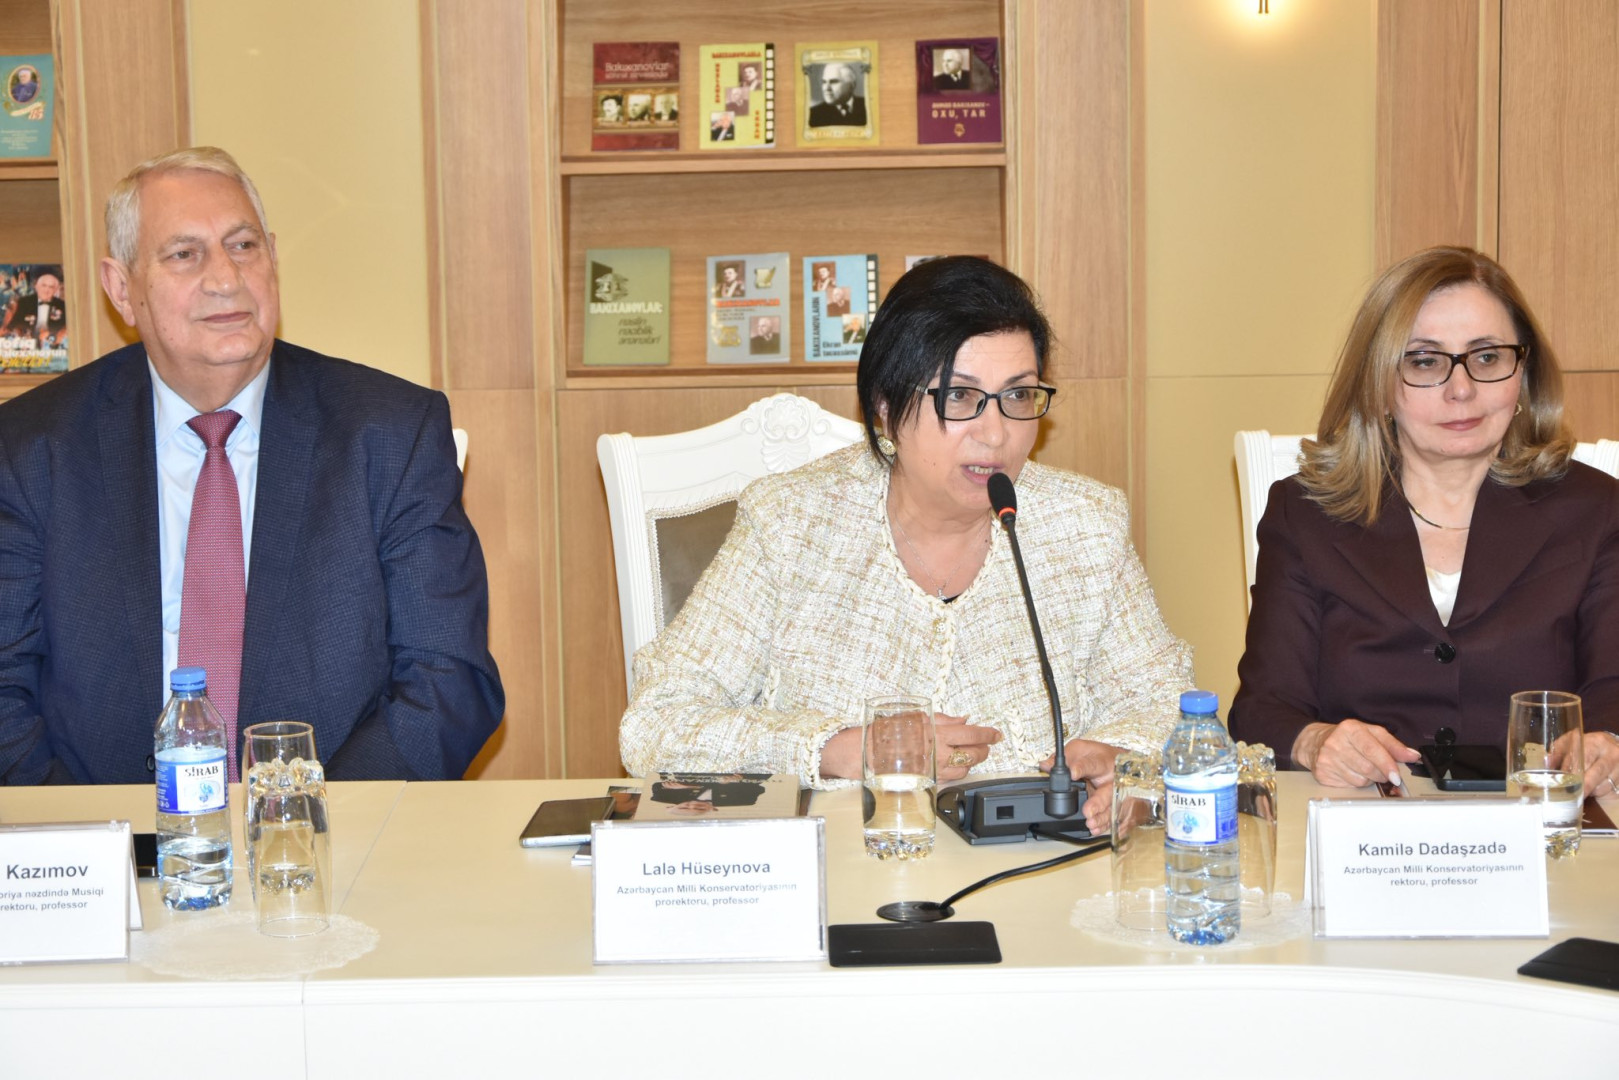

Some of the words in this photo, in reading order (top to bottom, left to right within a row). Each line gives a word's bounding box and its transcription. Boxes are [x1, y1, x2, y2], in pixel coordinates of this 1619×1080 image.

[932, 109, 958, 119] OXU,
[963, 109, 986, 118] TAR
[1358, 842, 1414, 857] Kamilə
[1418, 841, 1507, 858] Dadaşzadə
[6, 864, 89, 880] Kazımov
[643, 862, 676, 876] Lalə
[681, 861, 771, 878] Hüseynova
[1343, 865, 1401, 876] Azərbaycan
[1403, 864, 1423, 874] Milli
[1426, 863, 1524, 875] Konservatoriyasının
[1390, 877, 1429, 887] rektoru,
[1431, 877, 1478, 888] professor
[71, 887, 104, 898] Musiqi
[617, 884, 674, 896] Azərbaycan
[677, 884, 697, 894] Milli
[699, 883, 798, 894] Konservatoriyasının
[41, 901, 88, 912] professor
[655, 897, 710, 908] prorektoru,
[712, 896, 759, 908] professor
